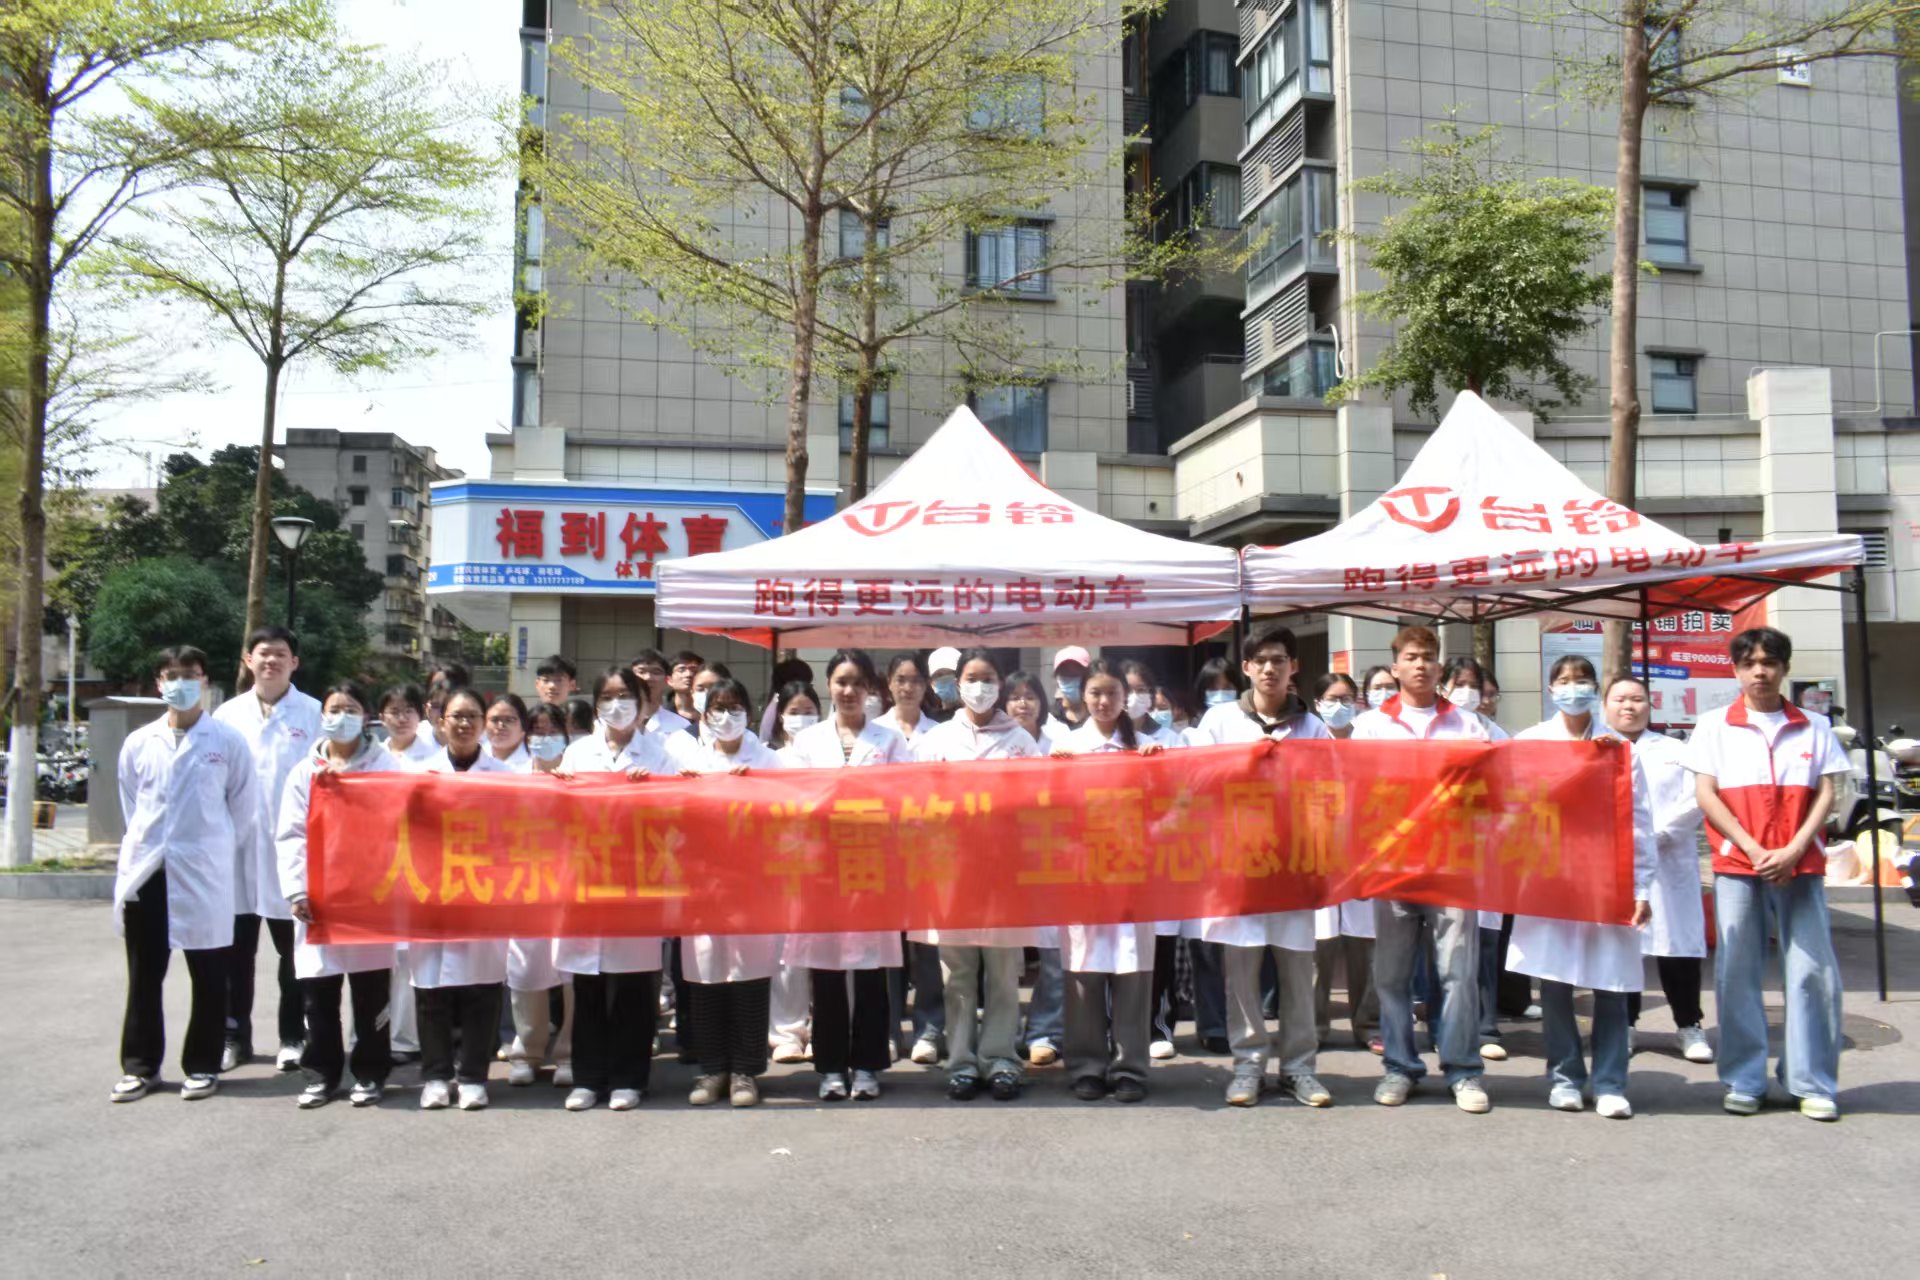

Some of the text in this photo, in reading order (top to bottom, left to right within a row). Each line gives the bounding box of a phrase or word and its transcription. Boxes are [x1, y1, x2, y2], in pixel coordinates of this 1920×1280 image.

[922, 499, 1076, 526] 台铃
[1480, 495, 1642, 535] 台铃
[753, 574, 1148, 617] 跑得更远的电动车
